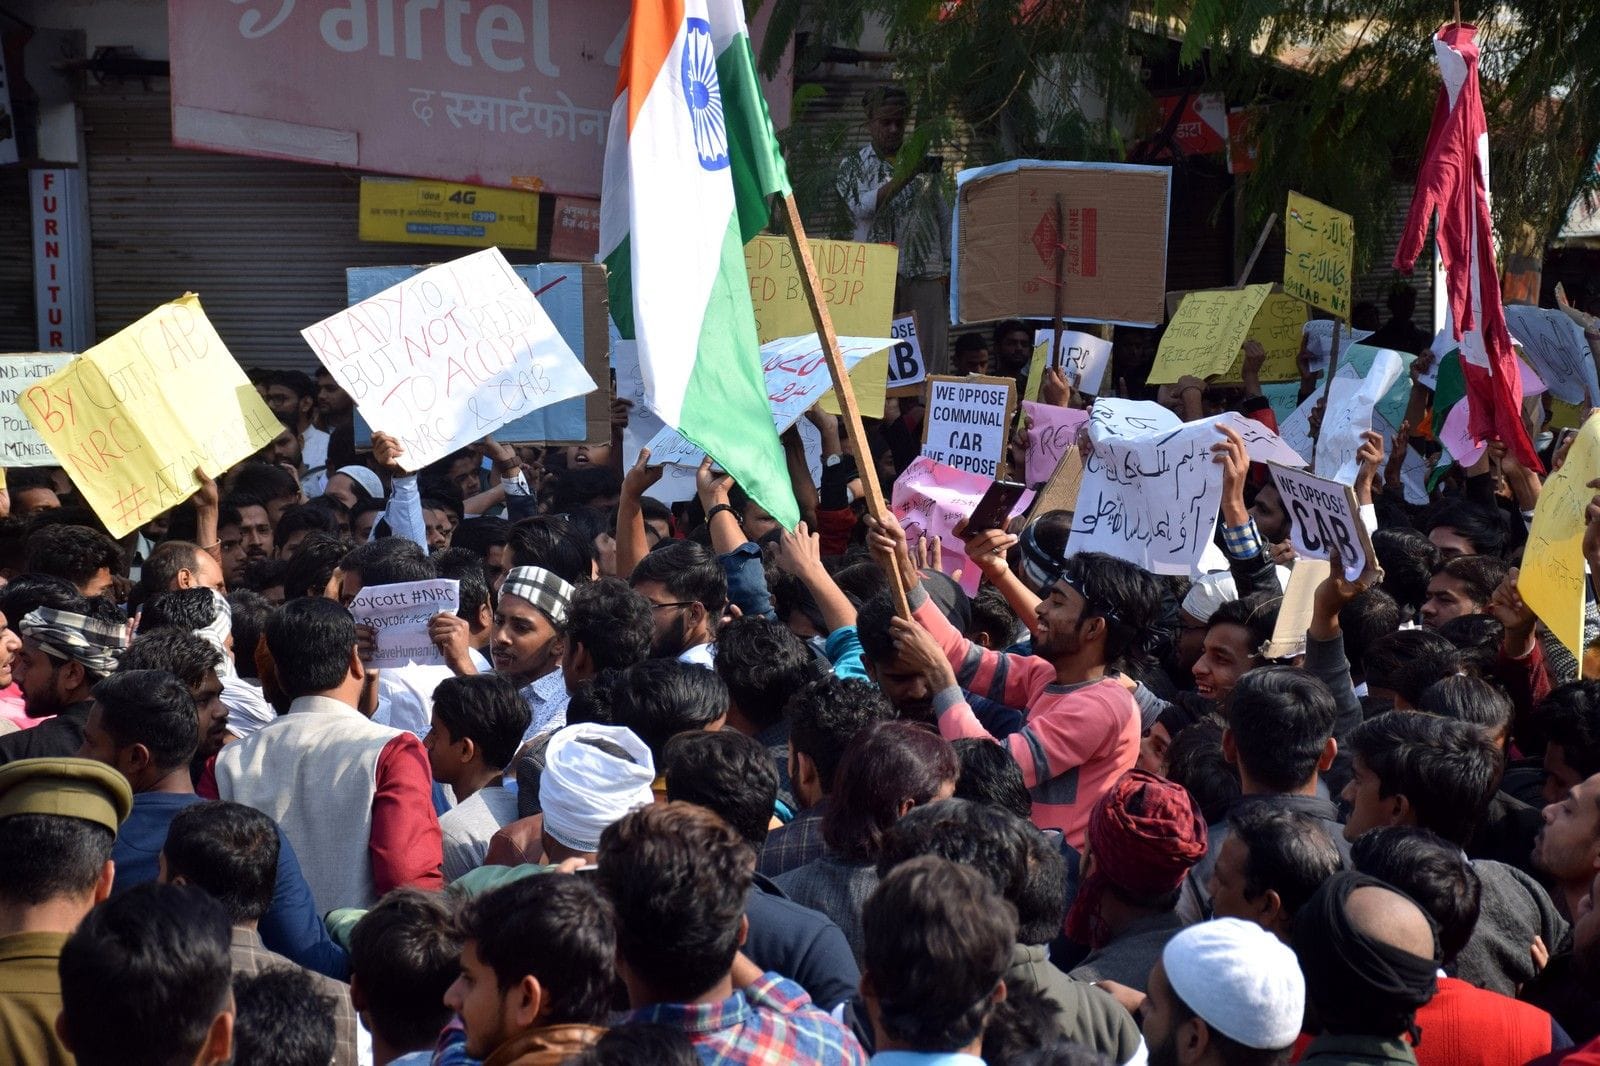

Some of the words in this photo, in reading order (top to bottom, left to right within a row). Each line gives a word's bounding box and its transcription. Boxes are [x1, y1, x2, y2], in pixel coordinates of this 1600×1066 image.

[448, 190, 476, 205] 4G
[309, 284, 404, 366] READY
[340, 342, 398, 400] BUT
[404, 306, 468, 367] NOT
[382, 375, 437, 425] TO
[499, 363, 553, 413] CAB
[936, 385, 955, 401] WE
[958, 388, 1006, 406] OPPOSE
[933, 406, 1002, 427] COMMUNAL
[4, 441, 53, 457] MINISTE
[948, 453, 996, 476] OPPOSE
[1277, 474, 1298, 497] WE
[1298, 483, 1347, 516] OPPOSE
[1292, 499, 1359, 567] CAB
[412, 588, 456, 604] #NRC
